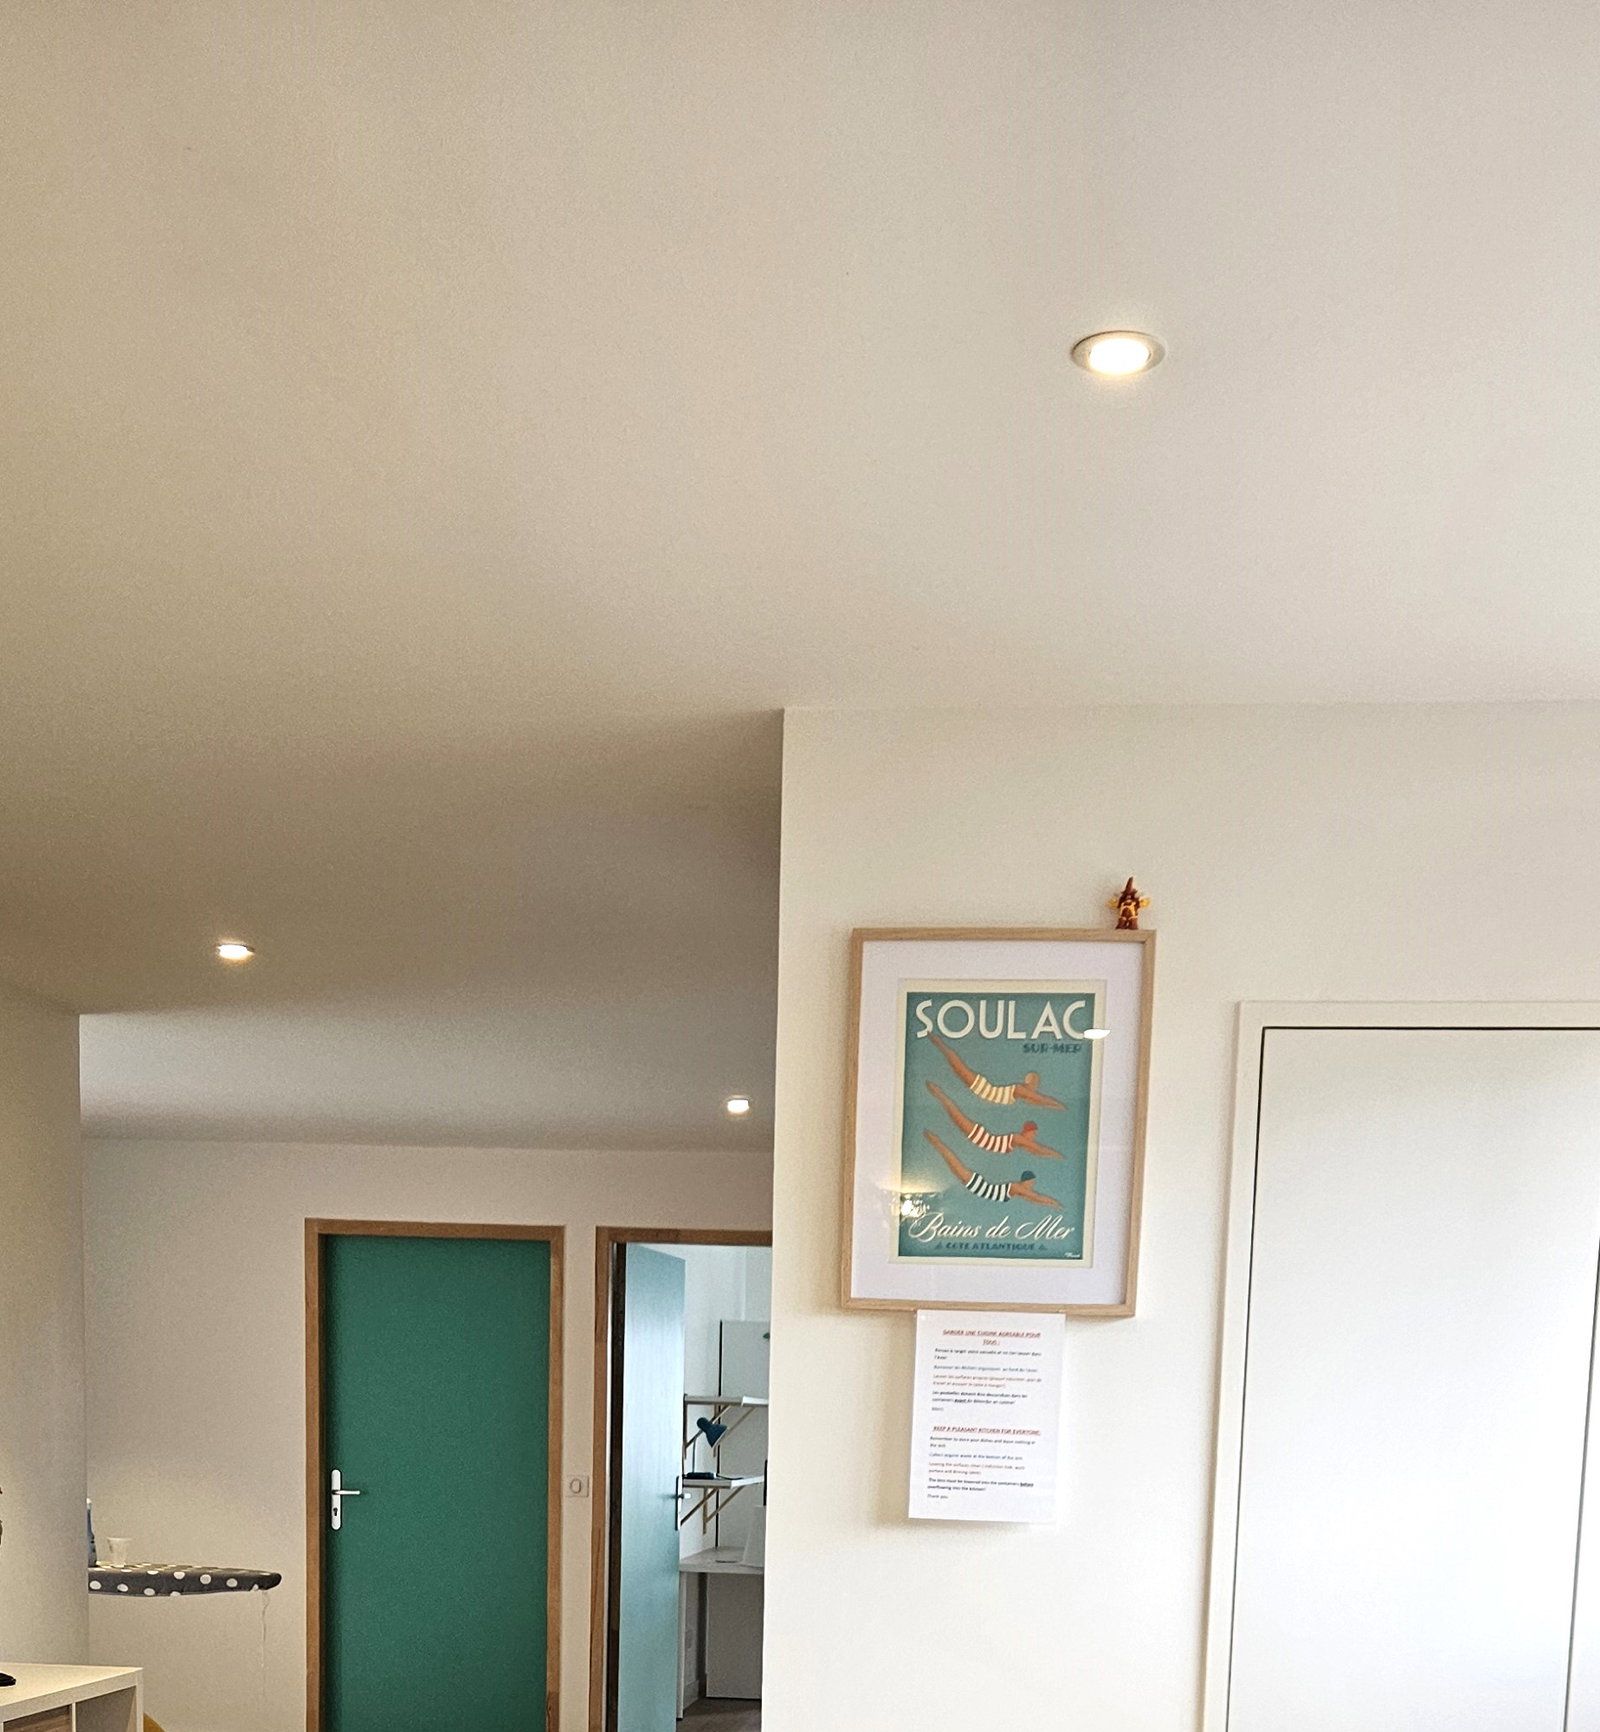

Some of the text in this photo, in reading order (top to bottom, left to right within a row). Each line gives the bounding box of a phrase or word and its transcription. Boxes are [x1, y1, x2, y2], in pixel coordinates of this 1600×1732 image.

[915, 999, 1087, 1040] SOULAC
[1023, 1043, 1083, 1054] SUR-MER
[908, 1212, 1076, 1243] Bains de Mer
